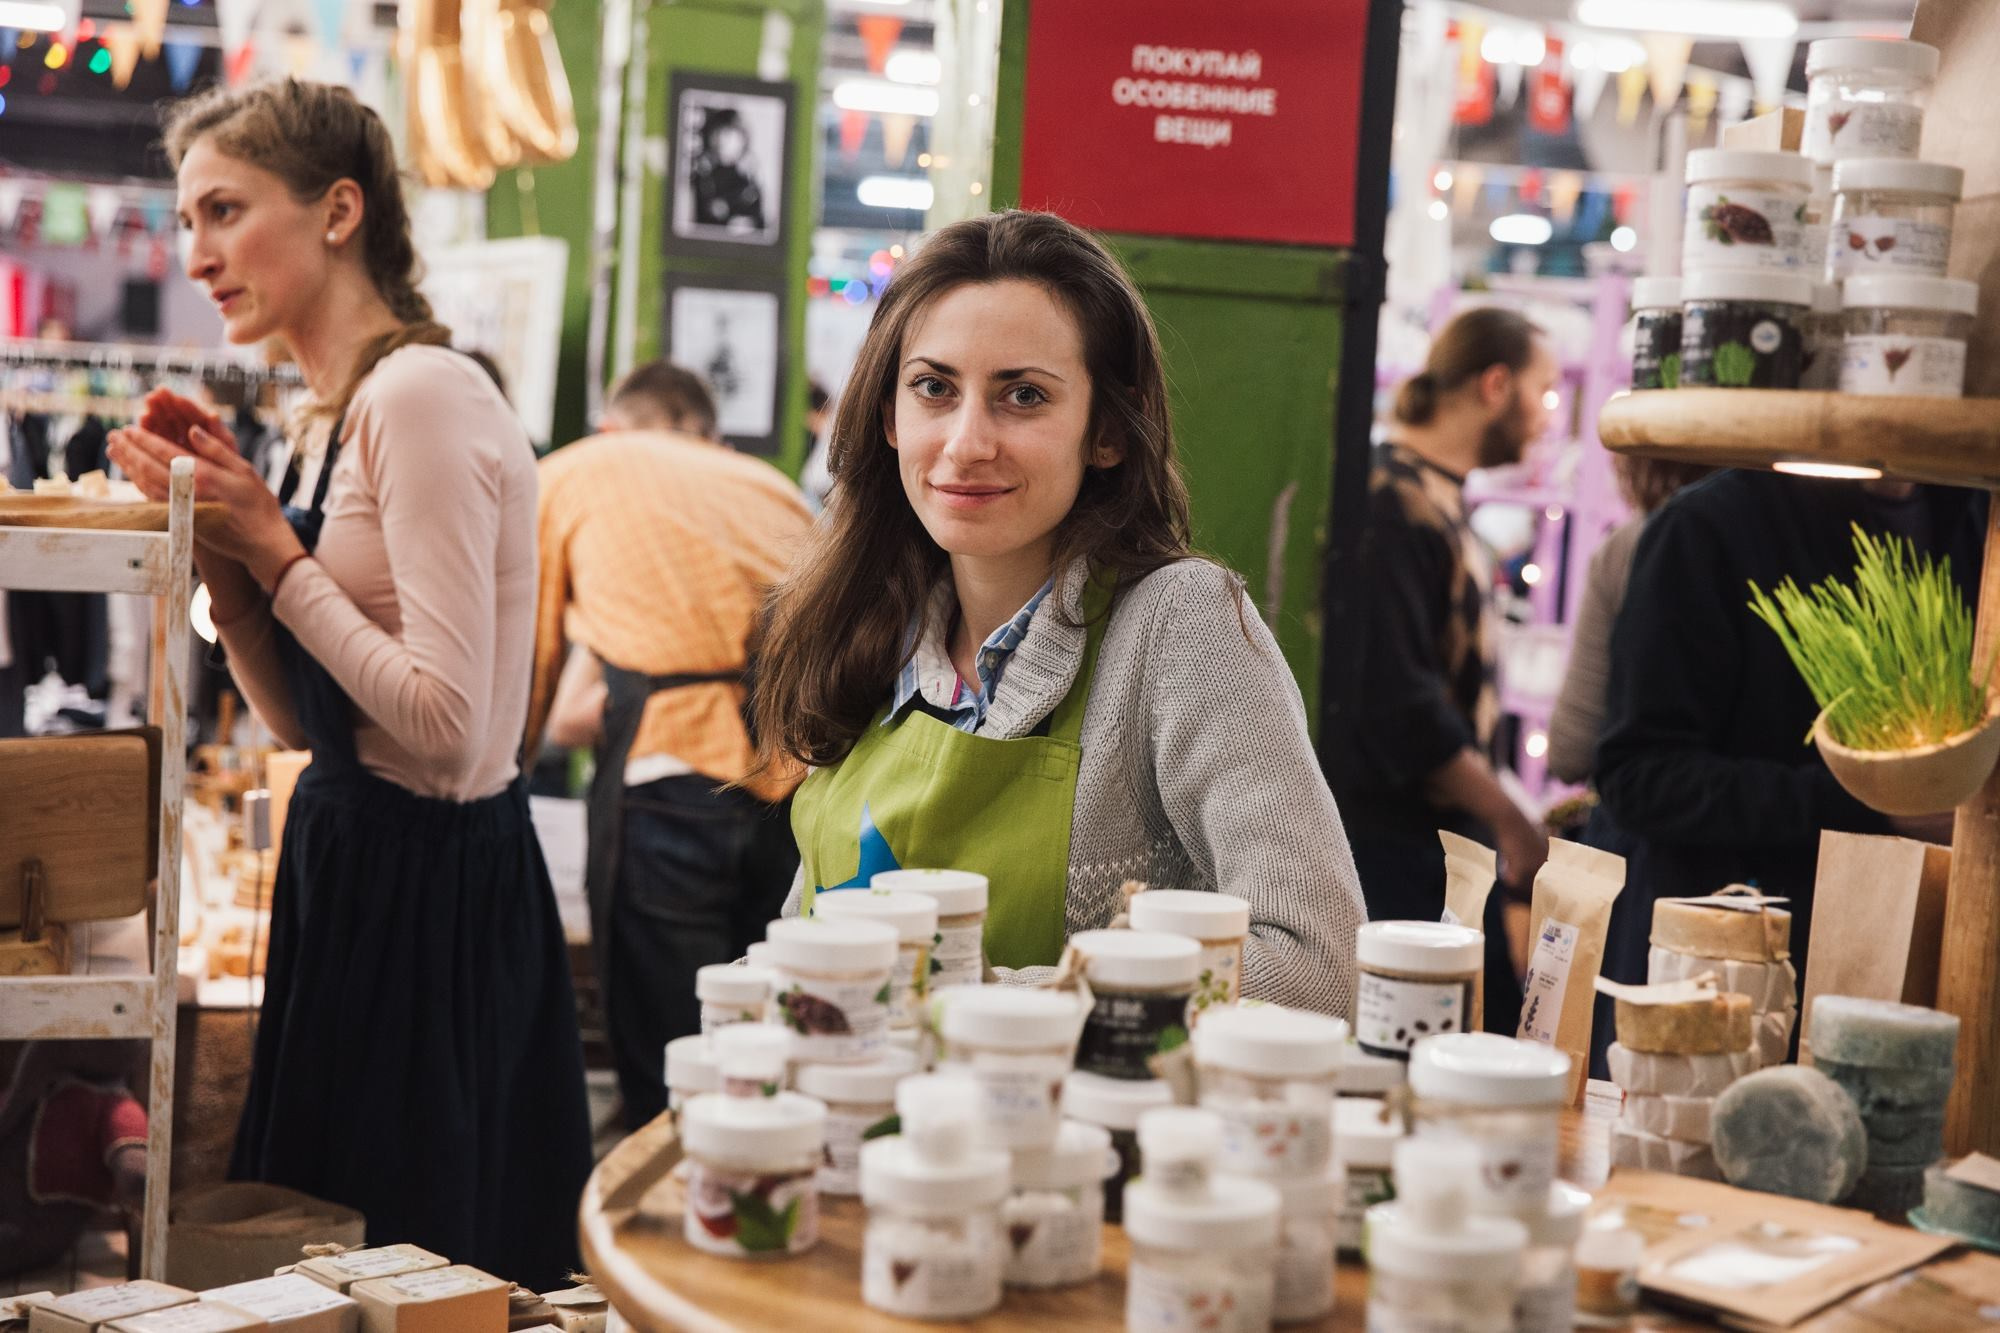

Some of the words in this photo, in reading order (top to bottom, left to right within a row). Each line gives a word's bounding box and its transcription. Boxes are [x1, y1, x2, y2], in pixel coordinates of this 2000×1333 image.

[1132, 45, 1262, 80] ПОКУПАЙ
[1112, 77, 1277, 116] ОСОБЕННЫЕ
[1155, 115, 1232, 149] ВЕЩИ
